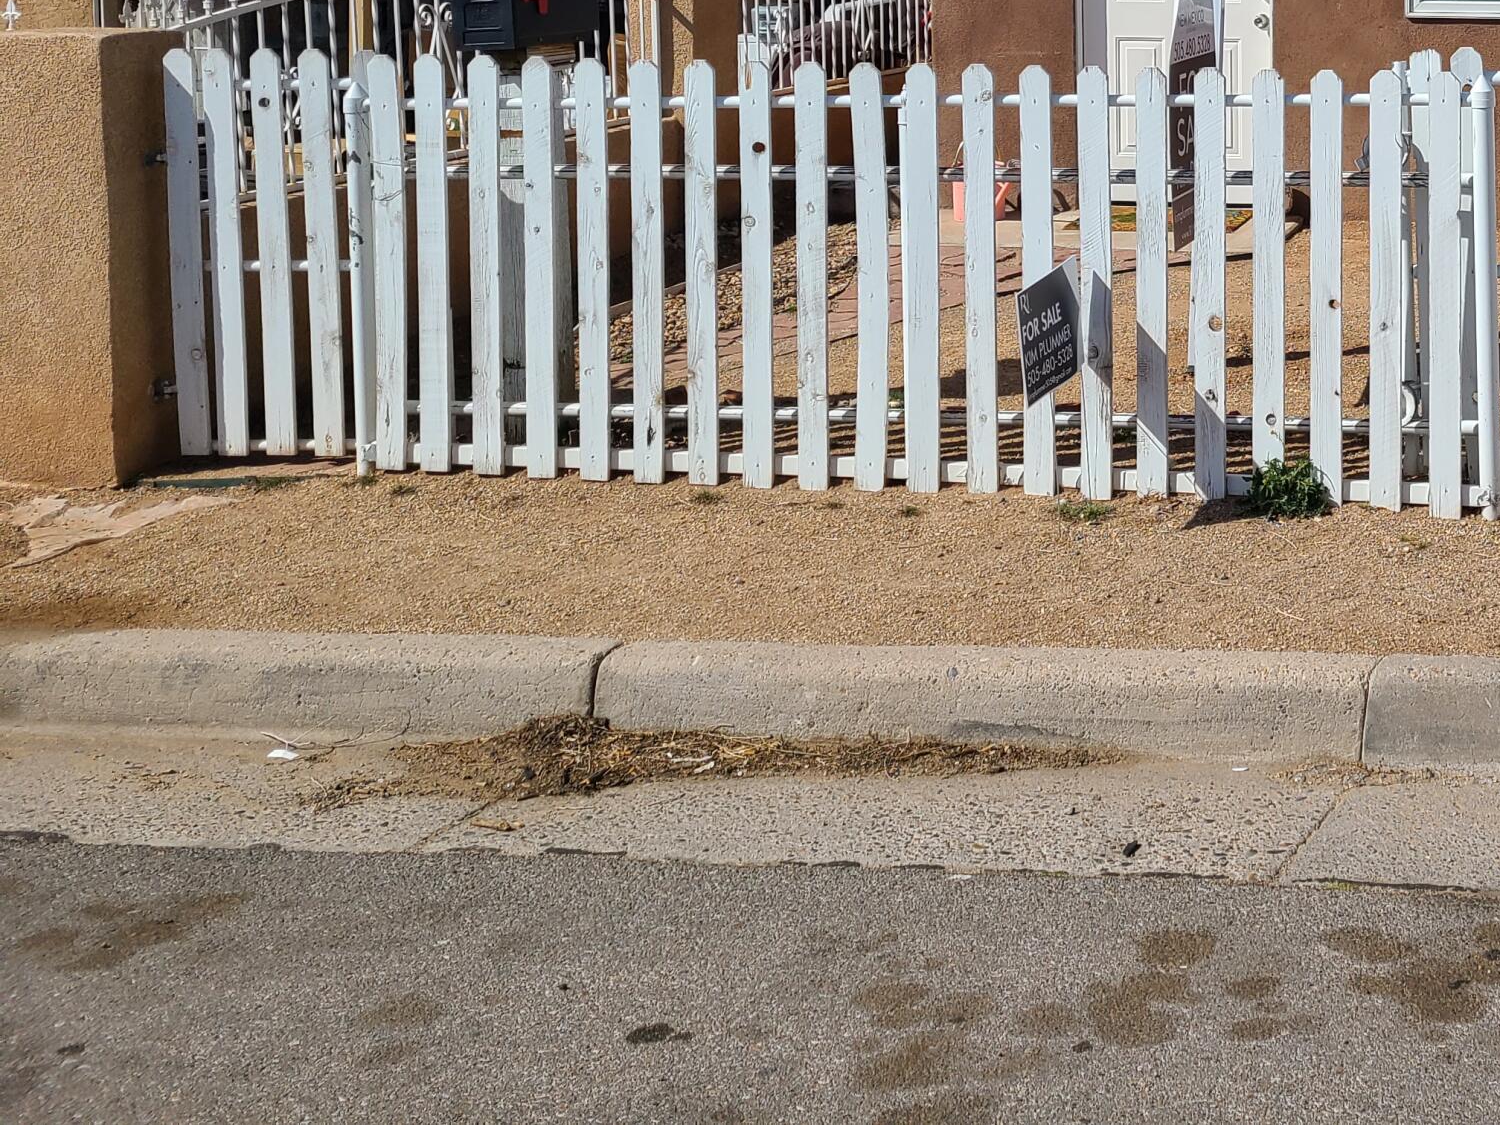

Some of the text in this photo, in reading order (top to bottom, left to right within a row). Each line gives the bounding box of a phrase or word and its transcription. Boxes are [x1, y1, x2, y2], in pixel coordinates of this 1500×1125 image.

[1177, 115, 1194, 156] SA
[1022, 302, 1062, 345] FOR SALE
[1025, 323, 1071, 369] KIM PLUMMER
[1027, 343, 1073, 387] 505-480-5328
